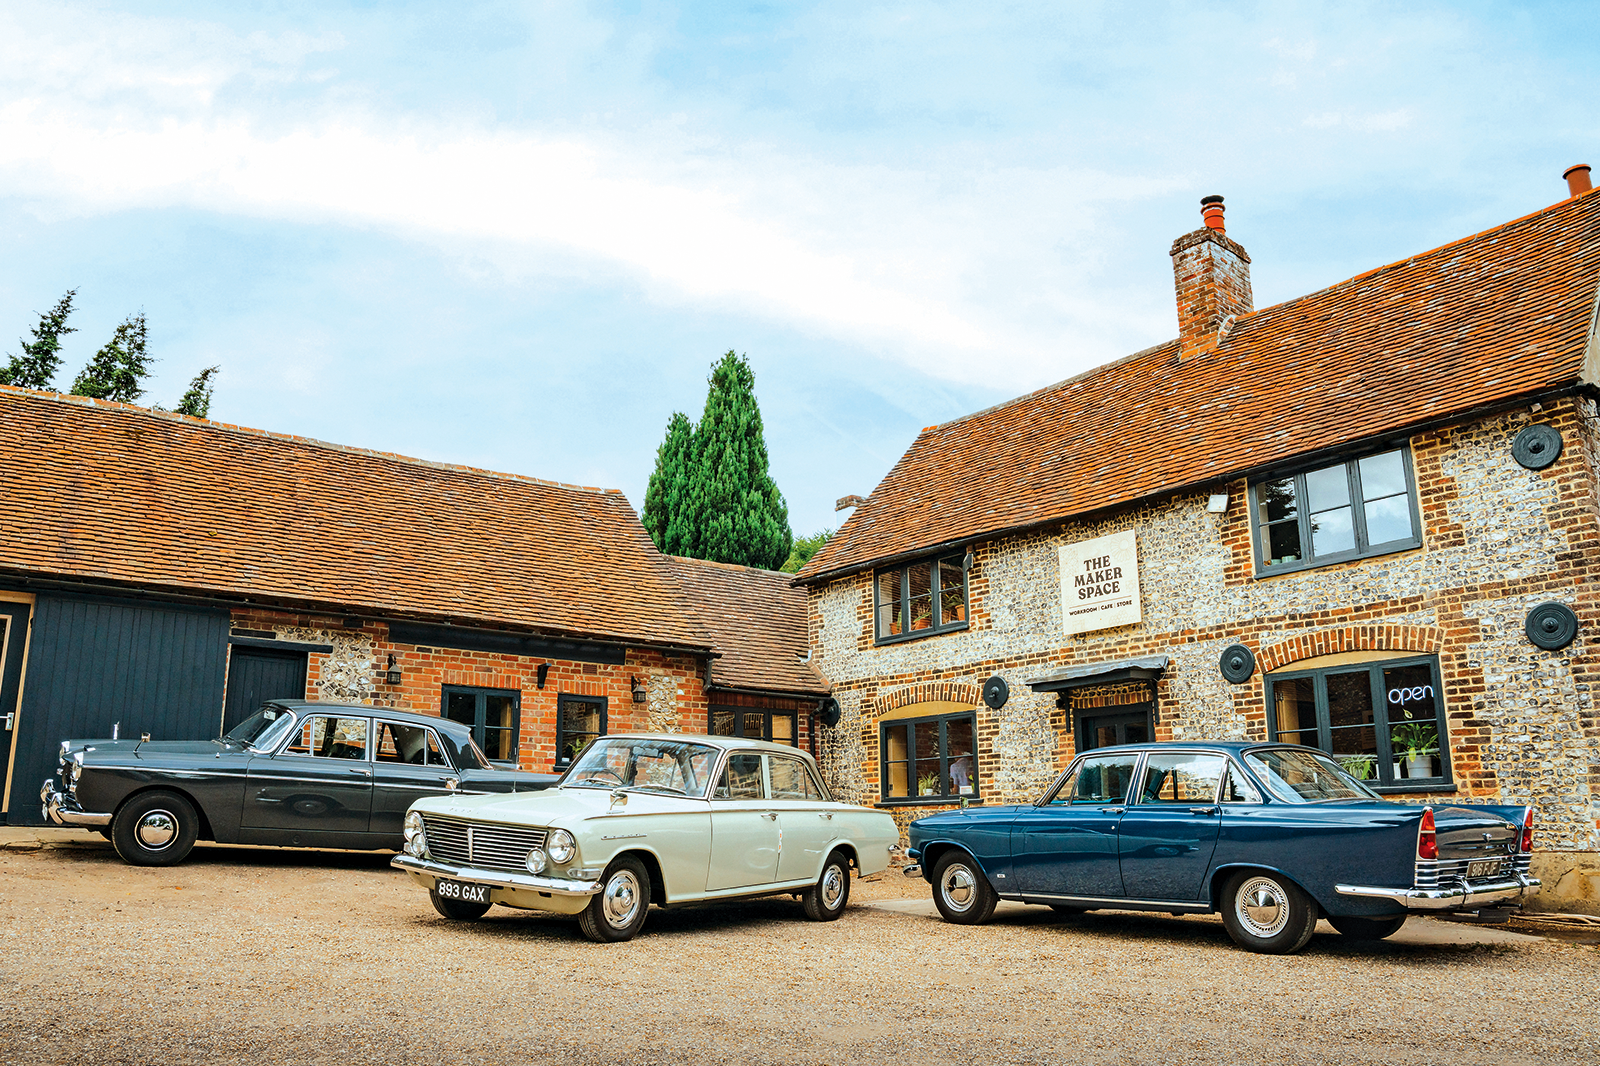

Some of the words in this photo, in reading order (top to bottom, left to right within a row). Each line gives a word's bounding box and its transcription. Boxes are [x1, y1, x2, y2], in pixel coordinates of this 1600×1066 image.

[1083, 555, 1111, 571] THE
[1074, 566, 1123, 587] MAKER
[1078, 581, 1121, 600] SPACE
[1069, 606, 1098, 616] WORKROOM
[1100, 603, 1114, 611] CAFE
[1116, 599, 1133, 608] STORE
[1388, 685, 1434, 706] open
[438, 882, 460, 898] 893
[462, 885, 485, 902] GAX
